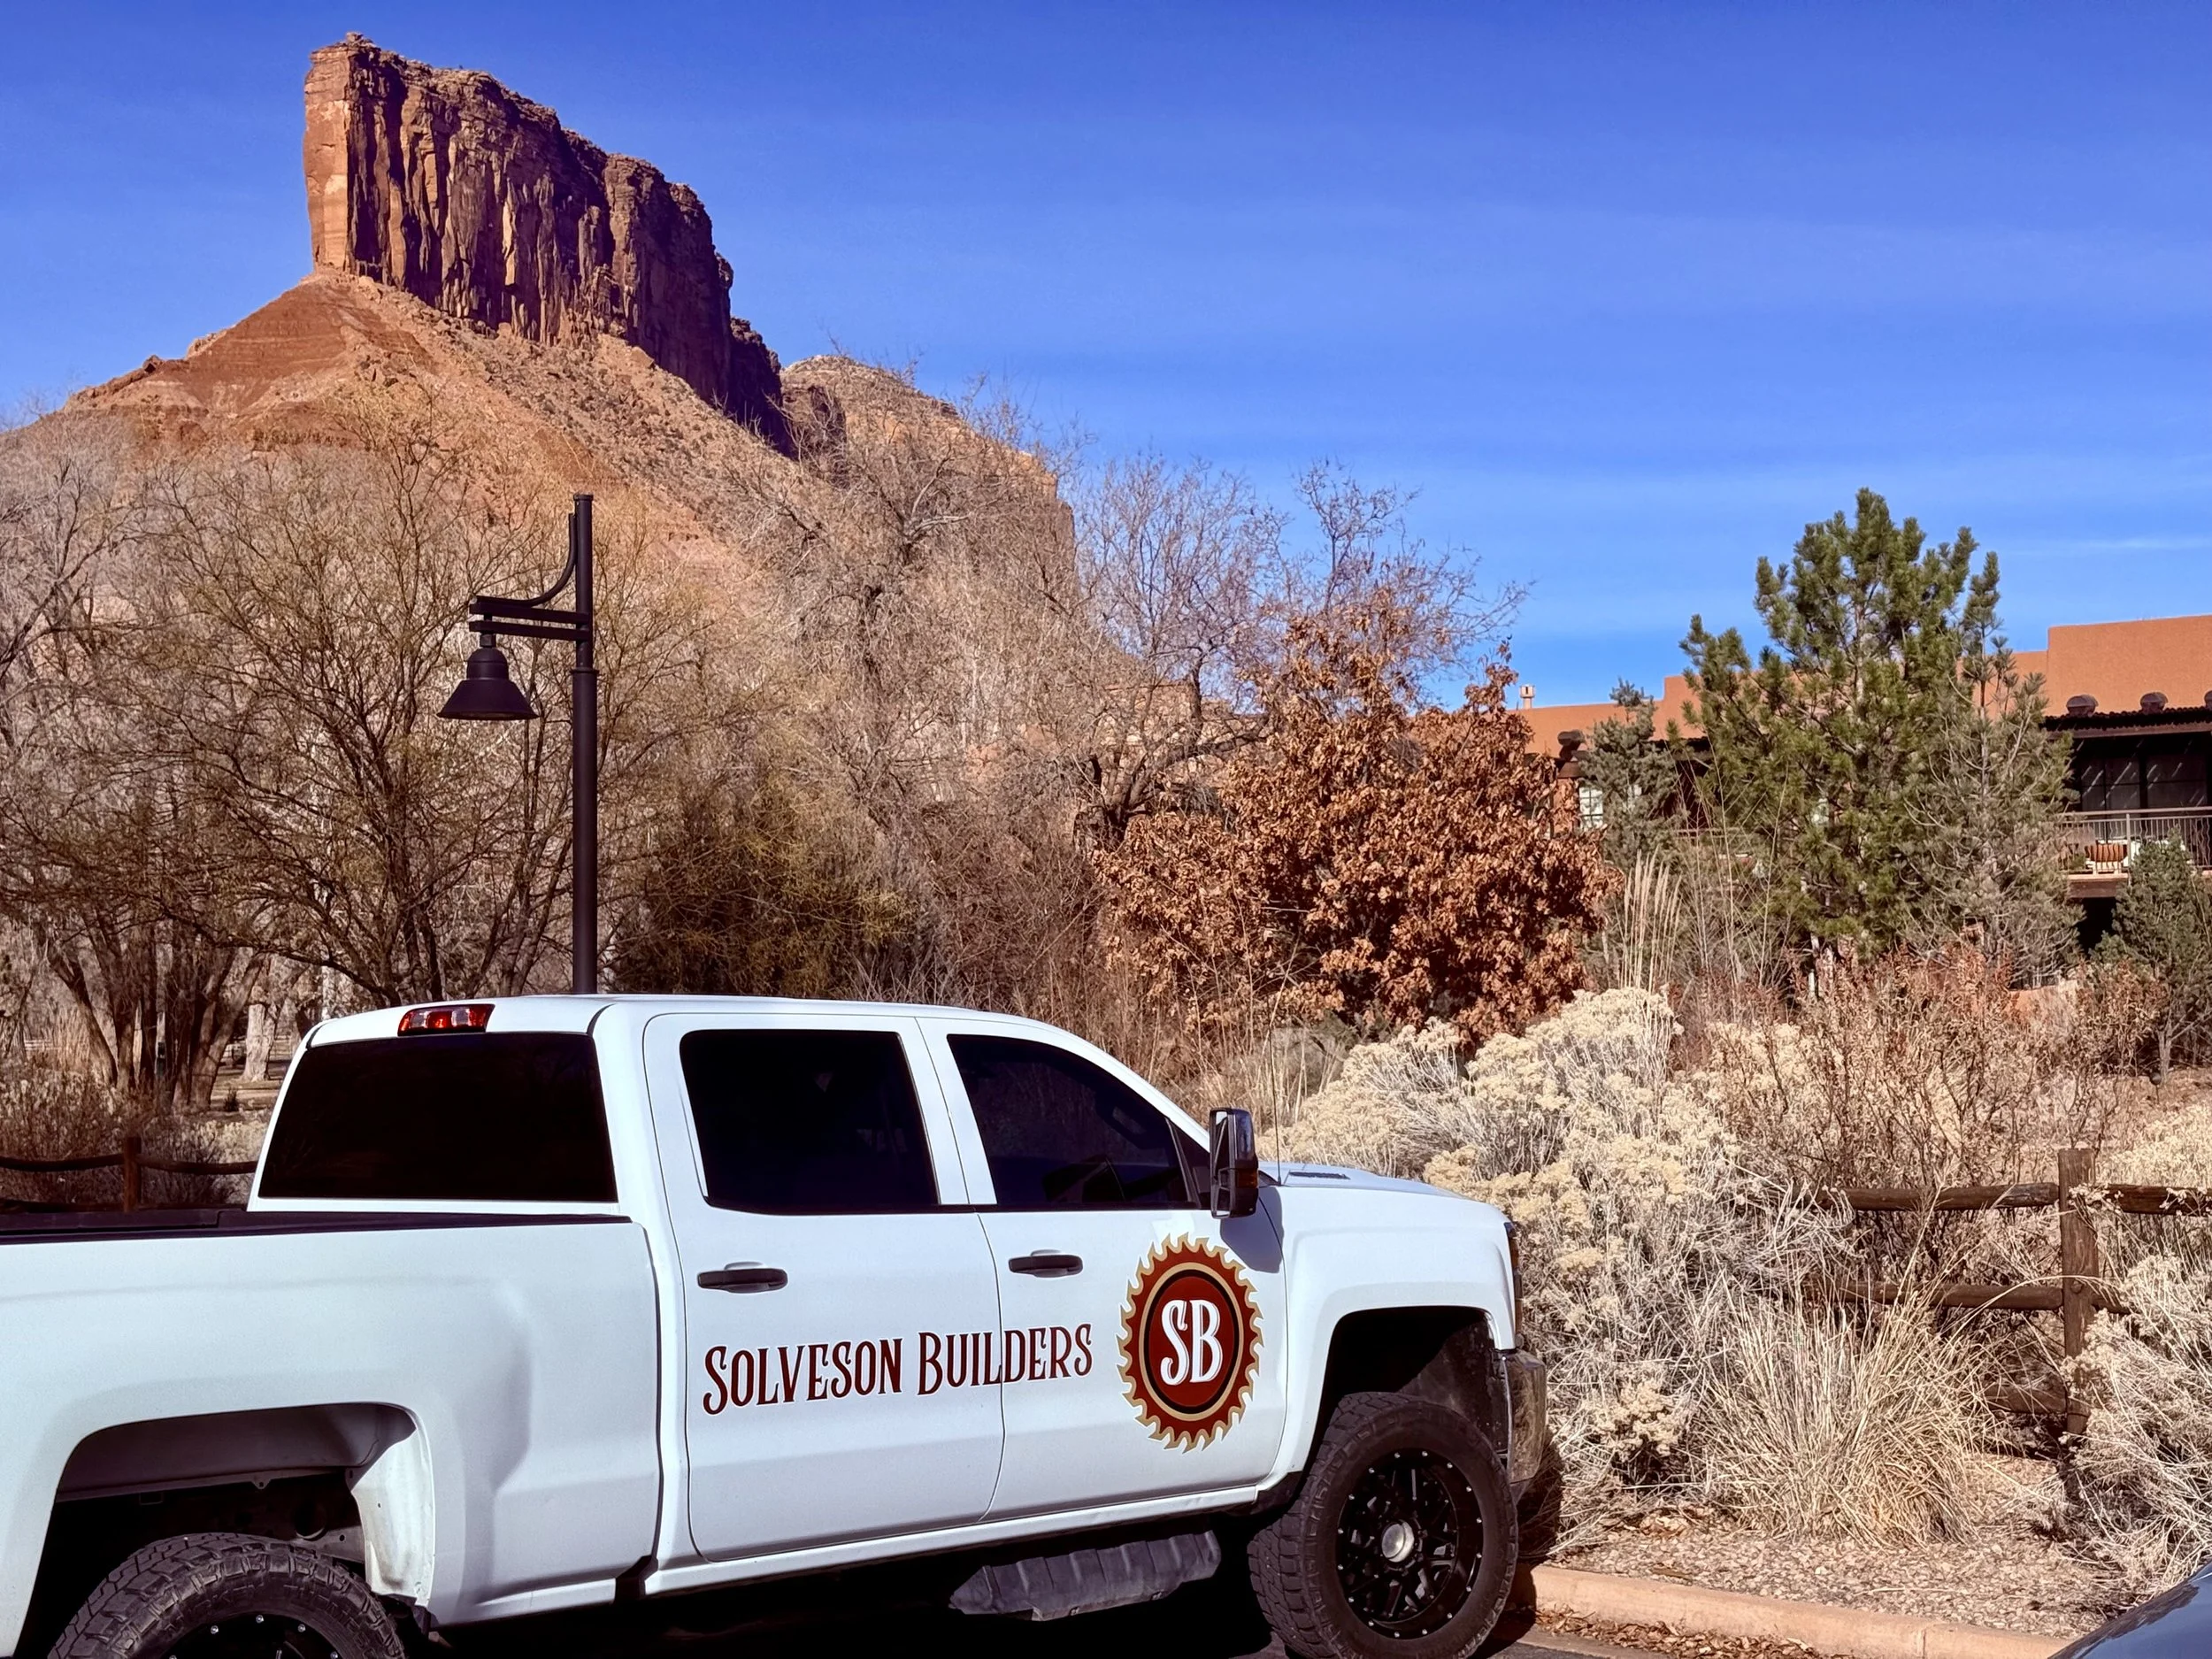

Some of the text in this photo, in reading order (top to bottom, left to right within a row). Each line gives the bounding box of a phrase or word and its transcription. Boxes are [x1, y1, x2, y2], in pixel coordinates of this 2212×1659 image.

[703, 1324, 1092, 1415] SOLVESON BUILDERS
[1160, 1299, 1224, 1386] SB
